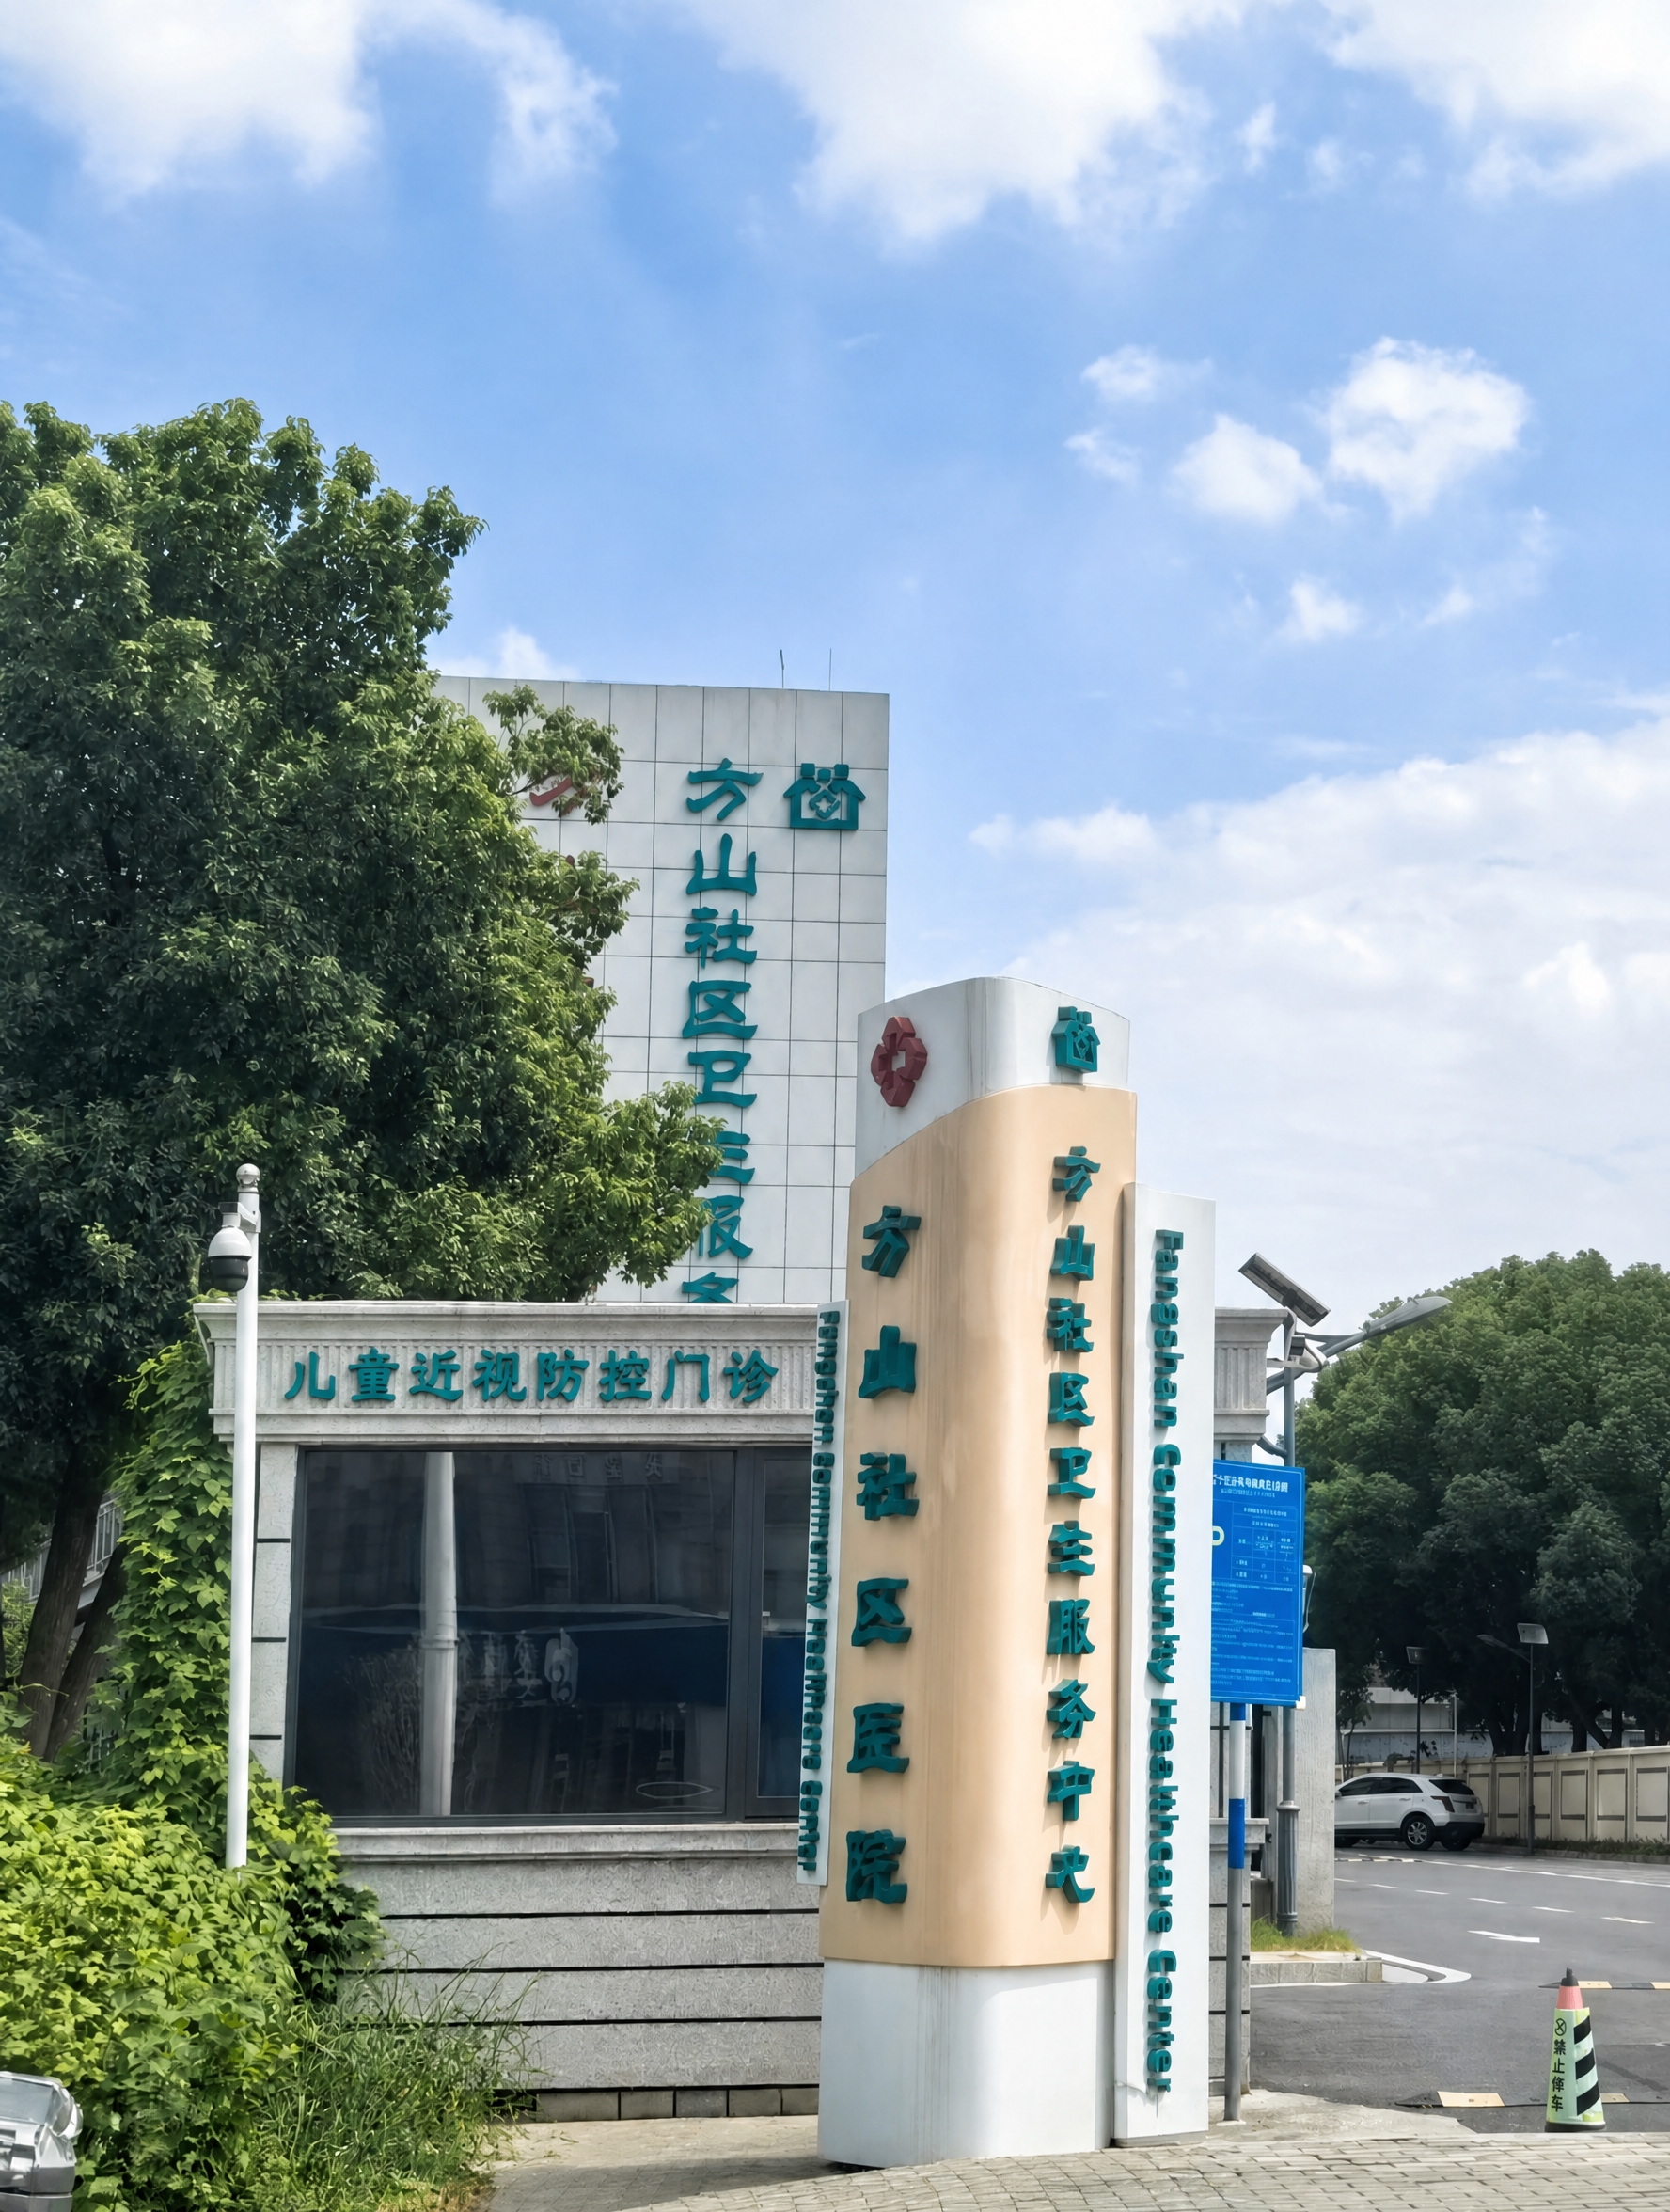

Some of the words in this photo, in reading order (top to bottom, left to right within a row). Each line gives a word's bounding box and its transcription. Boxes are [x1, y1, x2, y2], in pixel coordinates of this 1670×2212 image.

[284, 1347, 779, 1402] 儿童近视防控门诊
[1150, 1229, 1184, 1428] Fangshan
[846, 1207, 922, 1904] 方山社区医院
[1147, 1444, 1182, 1684] Community
[1147, 1698, 1179, 1934] Healthcare
[1146, 1950, 1176, 2093] Center
[1552, 2039, 1567, 2112] 禁止停车
